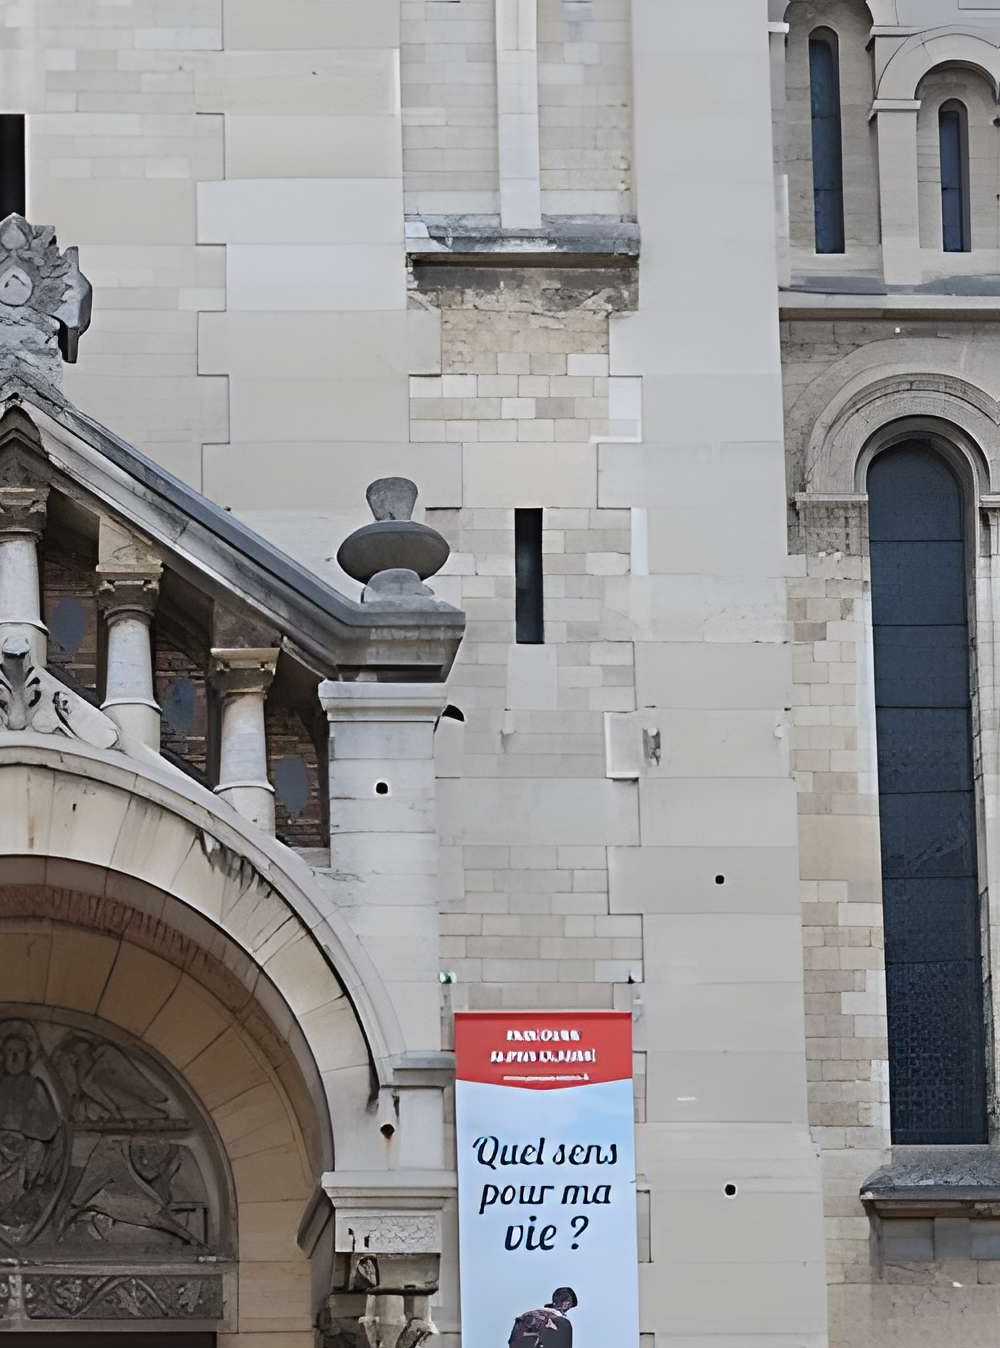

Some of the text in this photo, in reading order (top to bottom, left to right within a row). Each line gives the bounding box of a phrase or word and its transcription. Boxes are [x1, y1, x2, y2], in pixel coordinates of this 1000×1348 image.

[472, 1136, 618, 1170] Quel sens
[479, 1183, 612, 1215] pour ma
[504, 1215, 589, 1252] vie ?
